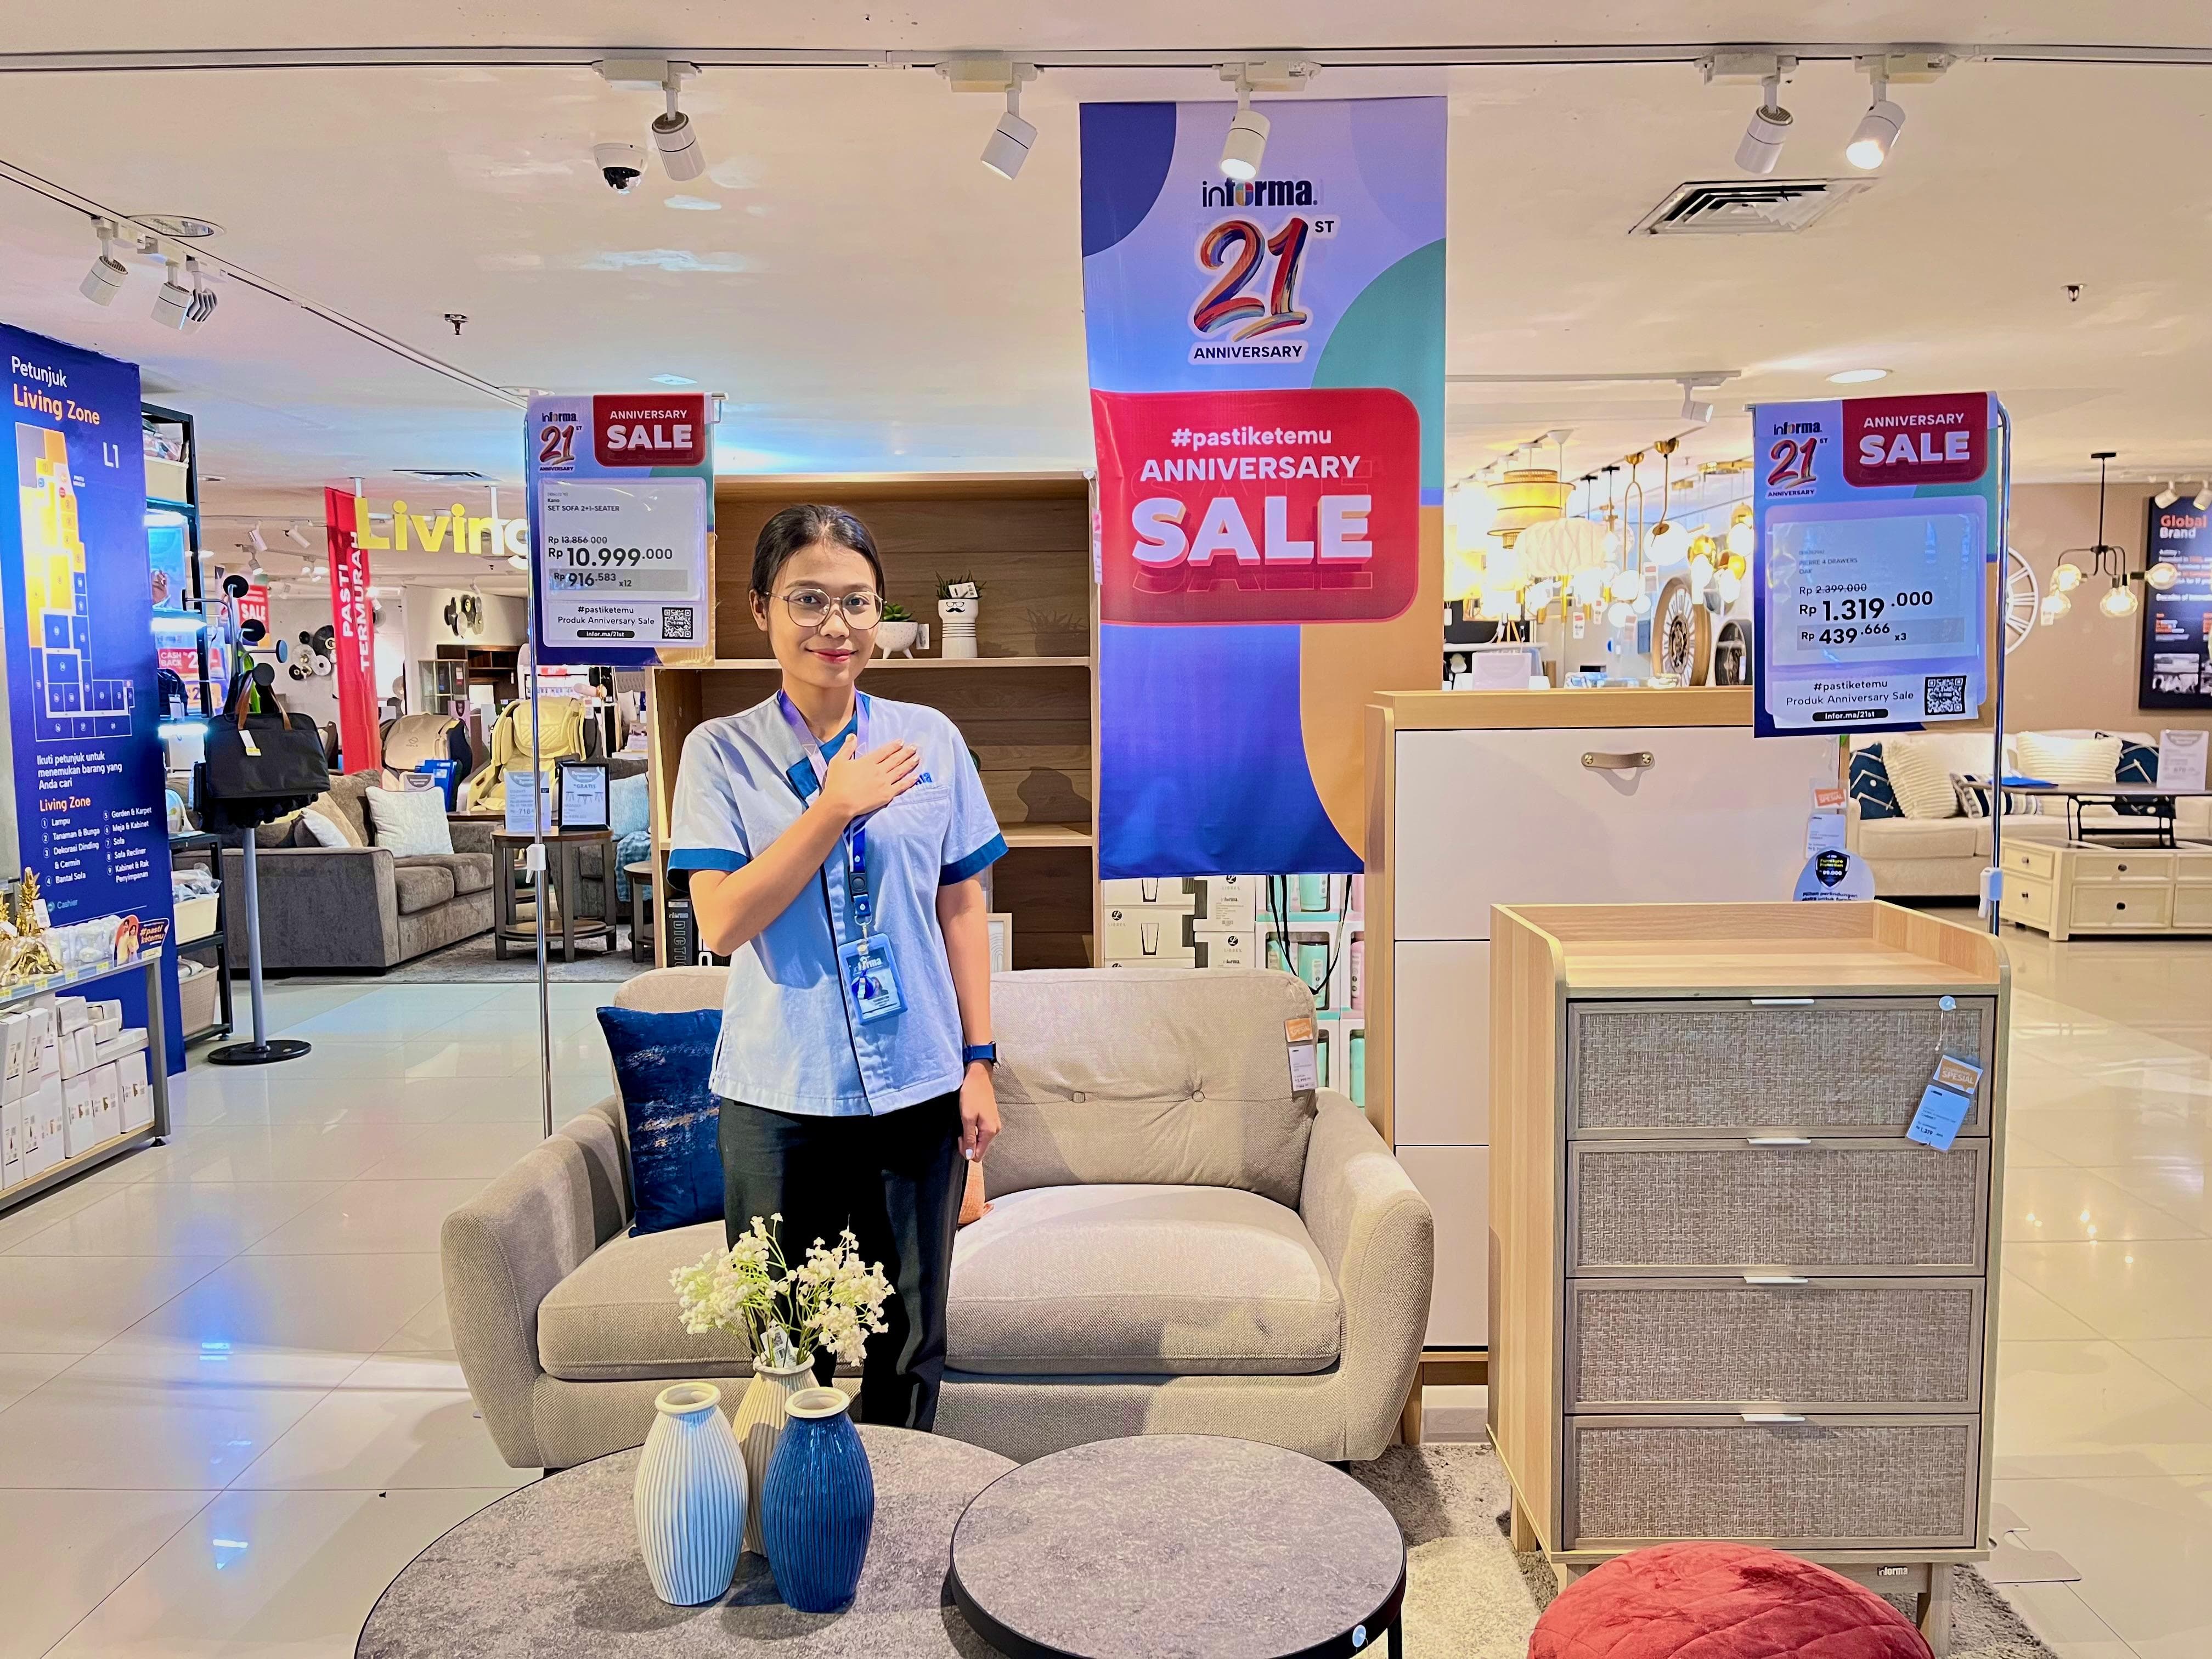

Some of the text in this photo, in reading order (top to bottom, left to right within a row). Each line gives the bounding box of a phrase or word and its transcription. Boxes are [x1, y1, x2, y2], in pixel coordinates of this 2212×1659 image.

[1193, 217, 1335, 342] 21 ST
[1193, 345, 1303, 359] ANNIVERSARY
[12, 356, 67, 387] Petunjuk
[13, 383, 100, 425] Living Zone
[610, 410, 687, 420] ANNIVERSARY
[1863, 413, 1965, 428] ANNIVERSARY
[606, 424, 693, 451] SALE
[1171, 426, 1333, 452] #pastiketemu
[539, 425, 575, 466] 21
[1859, 431, 1970, 467] SALE
[103, 441, 119, 469] L1
[1139, 455, 1361, 482] ANNIVERSARY
[1768, 437, 1818, 489] 21
[1768, 489, 1815, 498] ANNIVERSARY
[2160, 515, 2208, 528] Global
[354, 496, 529, 571] Living
[1131, 494, 1373, 569] SALE
[2159, 527, 2196, 539] Brand
[548, 548, 563, 559] Rp
[554, 572, 565, 580] Rp
[1799, 586, 1813, 595] Rp
[338, 564, 354, 637] PASTI
[241, 603, 266, 621] SALE
[577, 606, 634, 614] #pastiketemu
[1799, 604, 1817, 617] Rp
[588, 617, 635, 626] Anniversary
[1801, 631, 1815, 642] Rp
[1894, 633, 1907, 641] x3
[1813, 680, 1888, 692] #pastiketemu
[1786, 691, 1914, 707] Produk Anniversary Sale
[37, 751, 105, 766] Ikuti petunjuk untuk
[38, 763, 122, 778] menemukan barang yang
[38, 777, 72, 790] Anda cari
[40, 795, 92, 812] Living Zone
[111, 809, 131, 819] Gorden
[136, 806, 152, 817] Karpet
[51, 817, 70, 827] Lampu
[112, 823, 125, 833] Meja
[131, 820, 149, 830] Kabinet
[53, 831, 77, 841] Tanaman
[83, 827, 100, 837] Bunga
[53, 844, 78, 855] Dekorasi
[78, 841, 99, 851] Dinding
[113, 837, 125, 846] Sofa
[114, 851, 126, 860] Sofa
[126, 848, 146, 857] Recliner
[60, 857, 81, 868] Cermin
[115, 862, 134, 872] Kabinet
[139, 860, 150, 868] Rak
[55, 873, 74, 884] Bantal
[74, 872, 86, 880] Sofa
[116, 871, 149, 883] Penyimpanan
[57, 899, 78, 909] Cashier
[1942, 1070, 1974, 1084] SPESIAL
